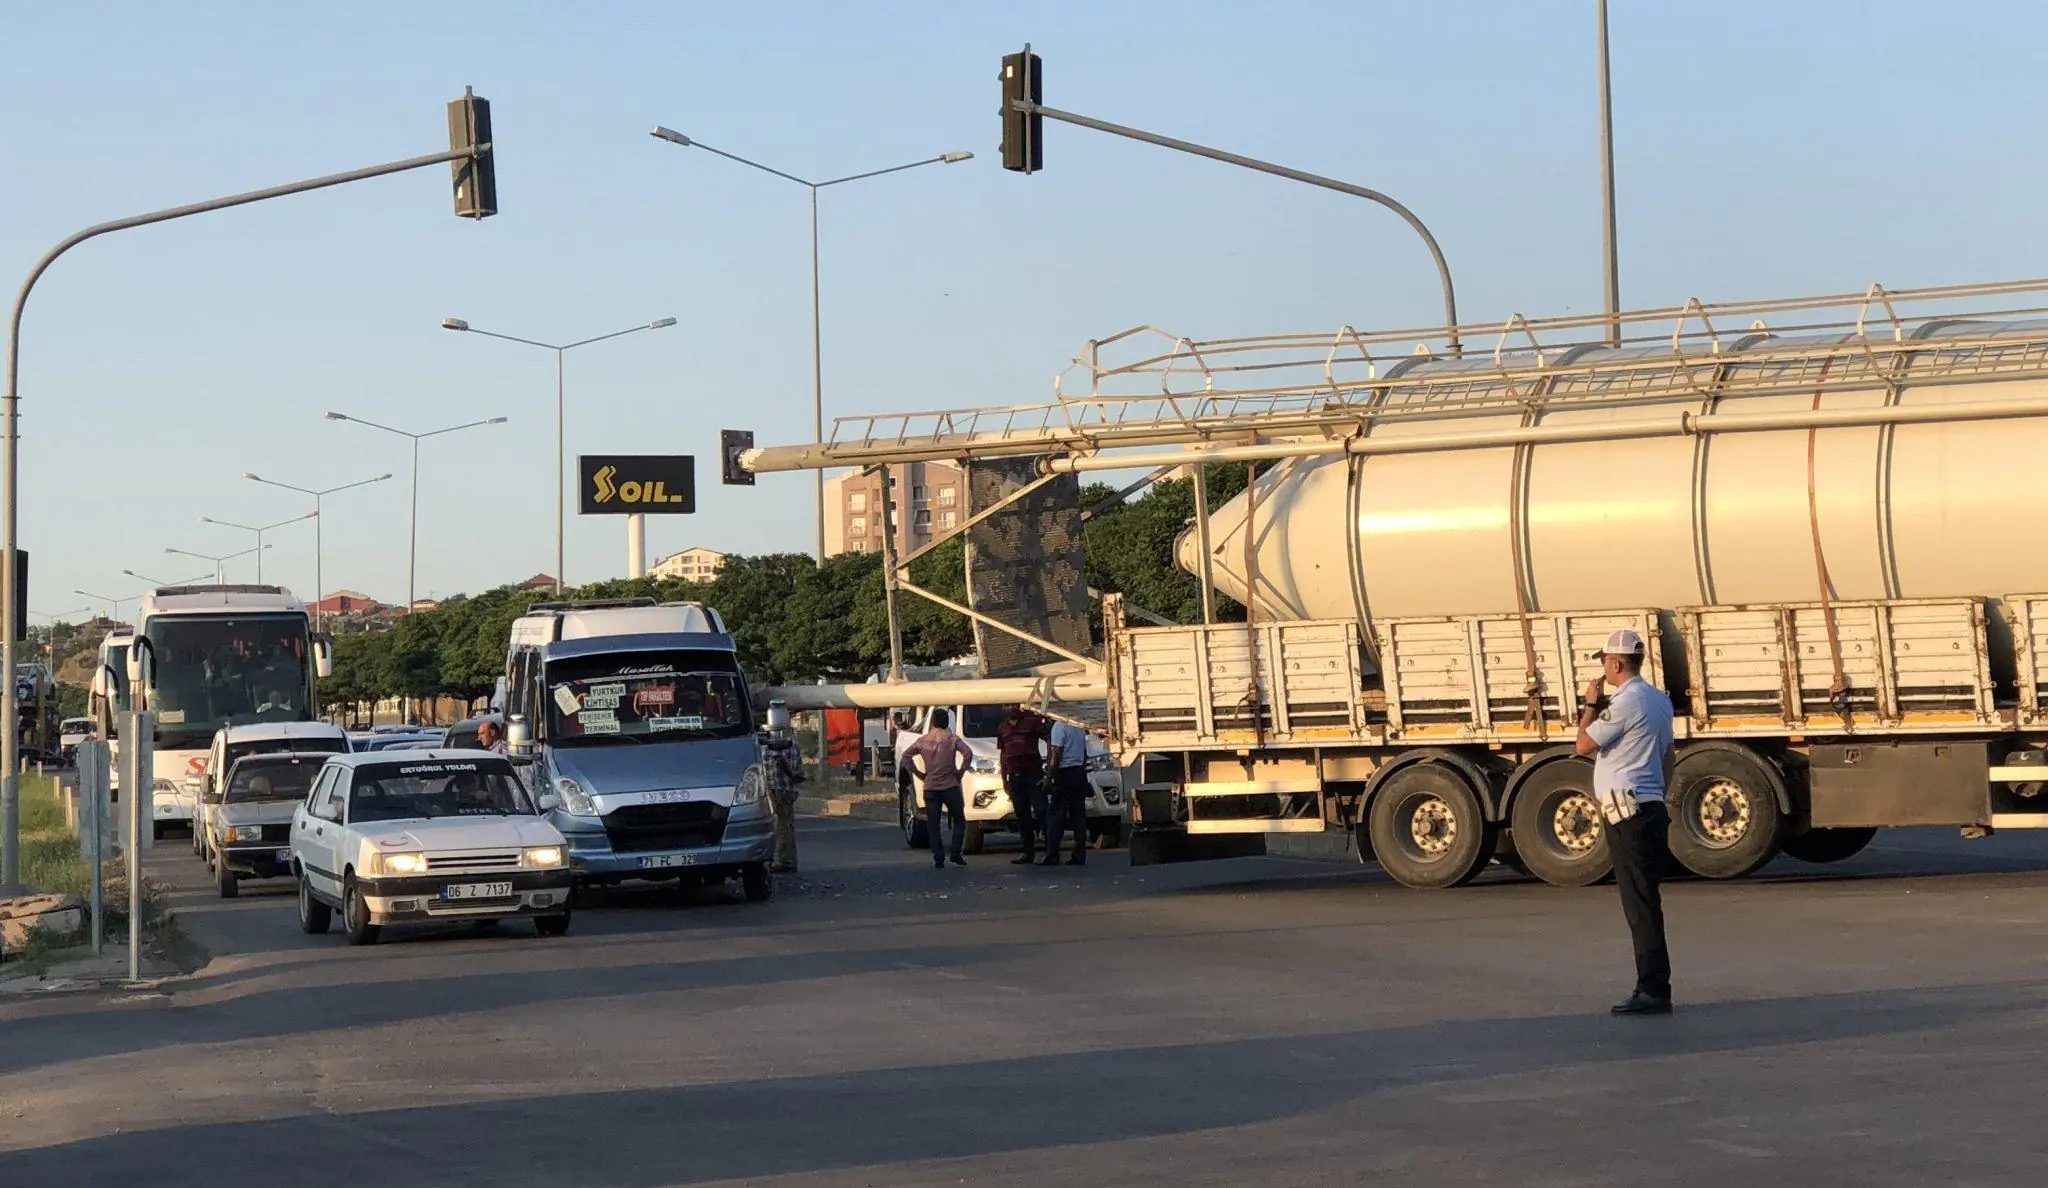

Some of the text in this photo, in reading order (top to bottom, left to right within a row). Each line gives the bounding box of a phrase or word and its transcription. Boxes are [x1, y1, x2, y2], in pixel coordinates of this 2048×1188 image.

[592, 687, 625, 696] YURTKUR
[640, 790, 691, 803] IVECO
[643, 857, 654, 868] 71
[660, 856, 673, 867] FC
[448, 883, 510, 898] 06 Z 7137
